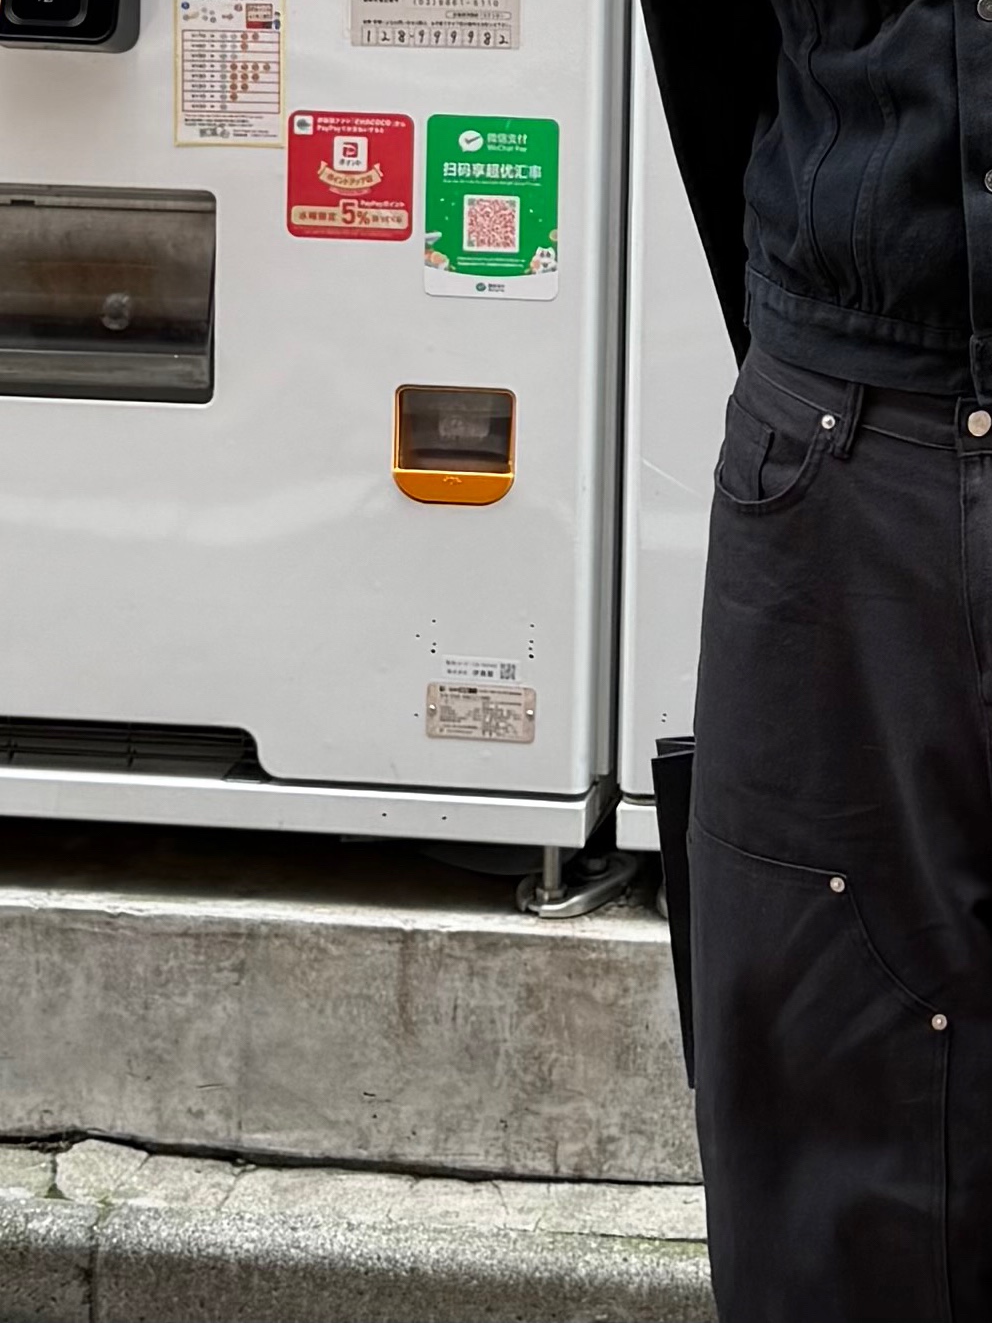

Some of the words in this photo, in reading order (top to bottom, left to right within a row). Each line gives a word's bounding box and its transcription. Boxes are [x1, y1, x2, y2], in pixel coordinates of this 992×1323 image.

[443, 161, 543, 180] 扫码享超优汇率
[341, 202, 371, 226] 5%
